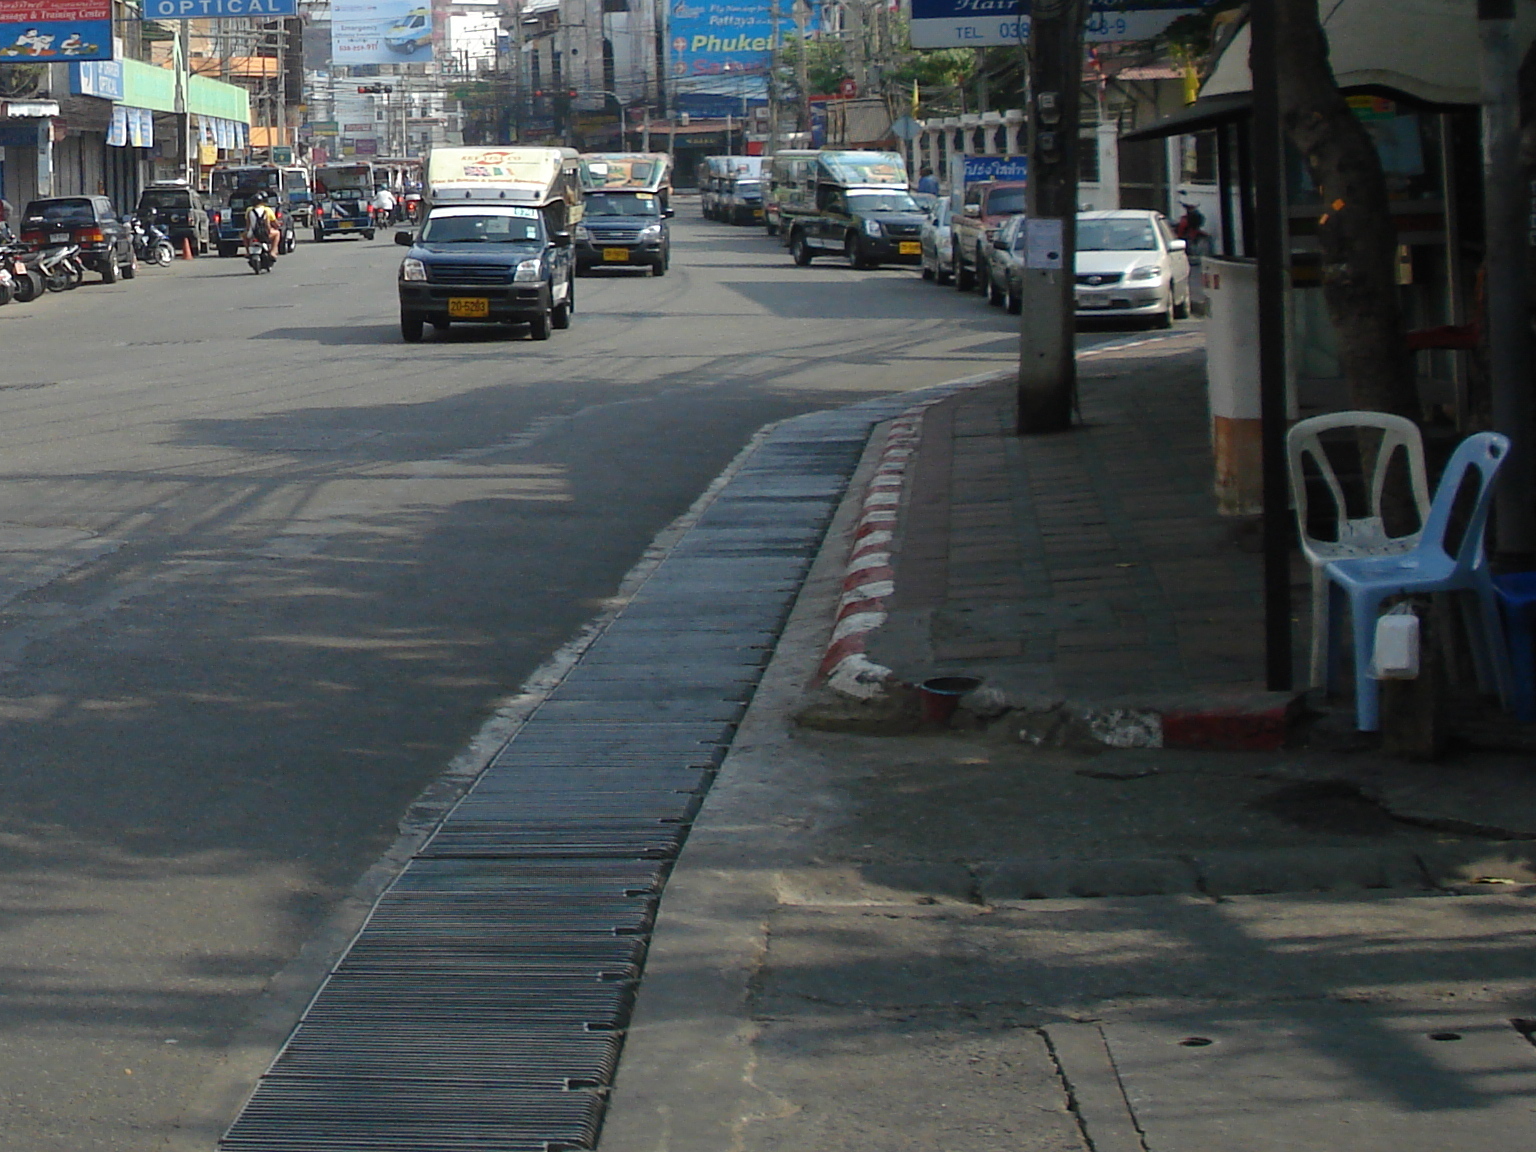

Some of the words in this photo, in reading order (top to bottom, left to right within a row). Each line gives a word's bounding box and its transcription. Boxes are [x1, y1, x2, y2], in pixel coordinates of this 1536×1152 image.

[40, 9, 77, 21] Training
[78, 9, 107, 19] Center
[709, 14, 755, 29] Pattaya
[691, 33, 775, 53] Phuket
